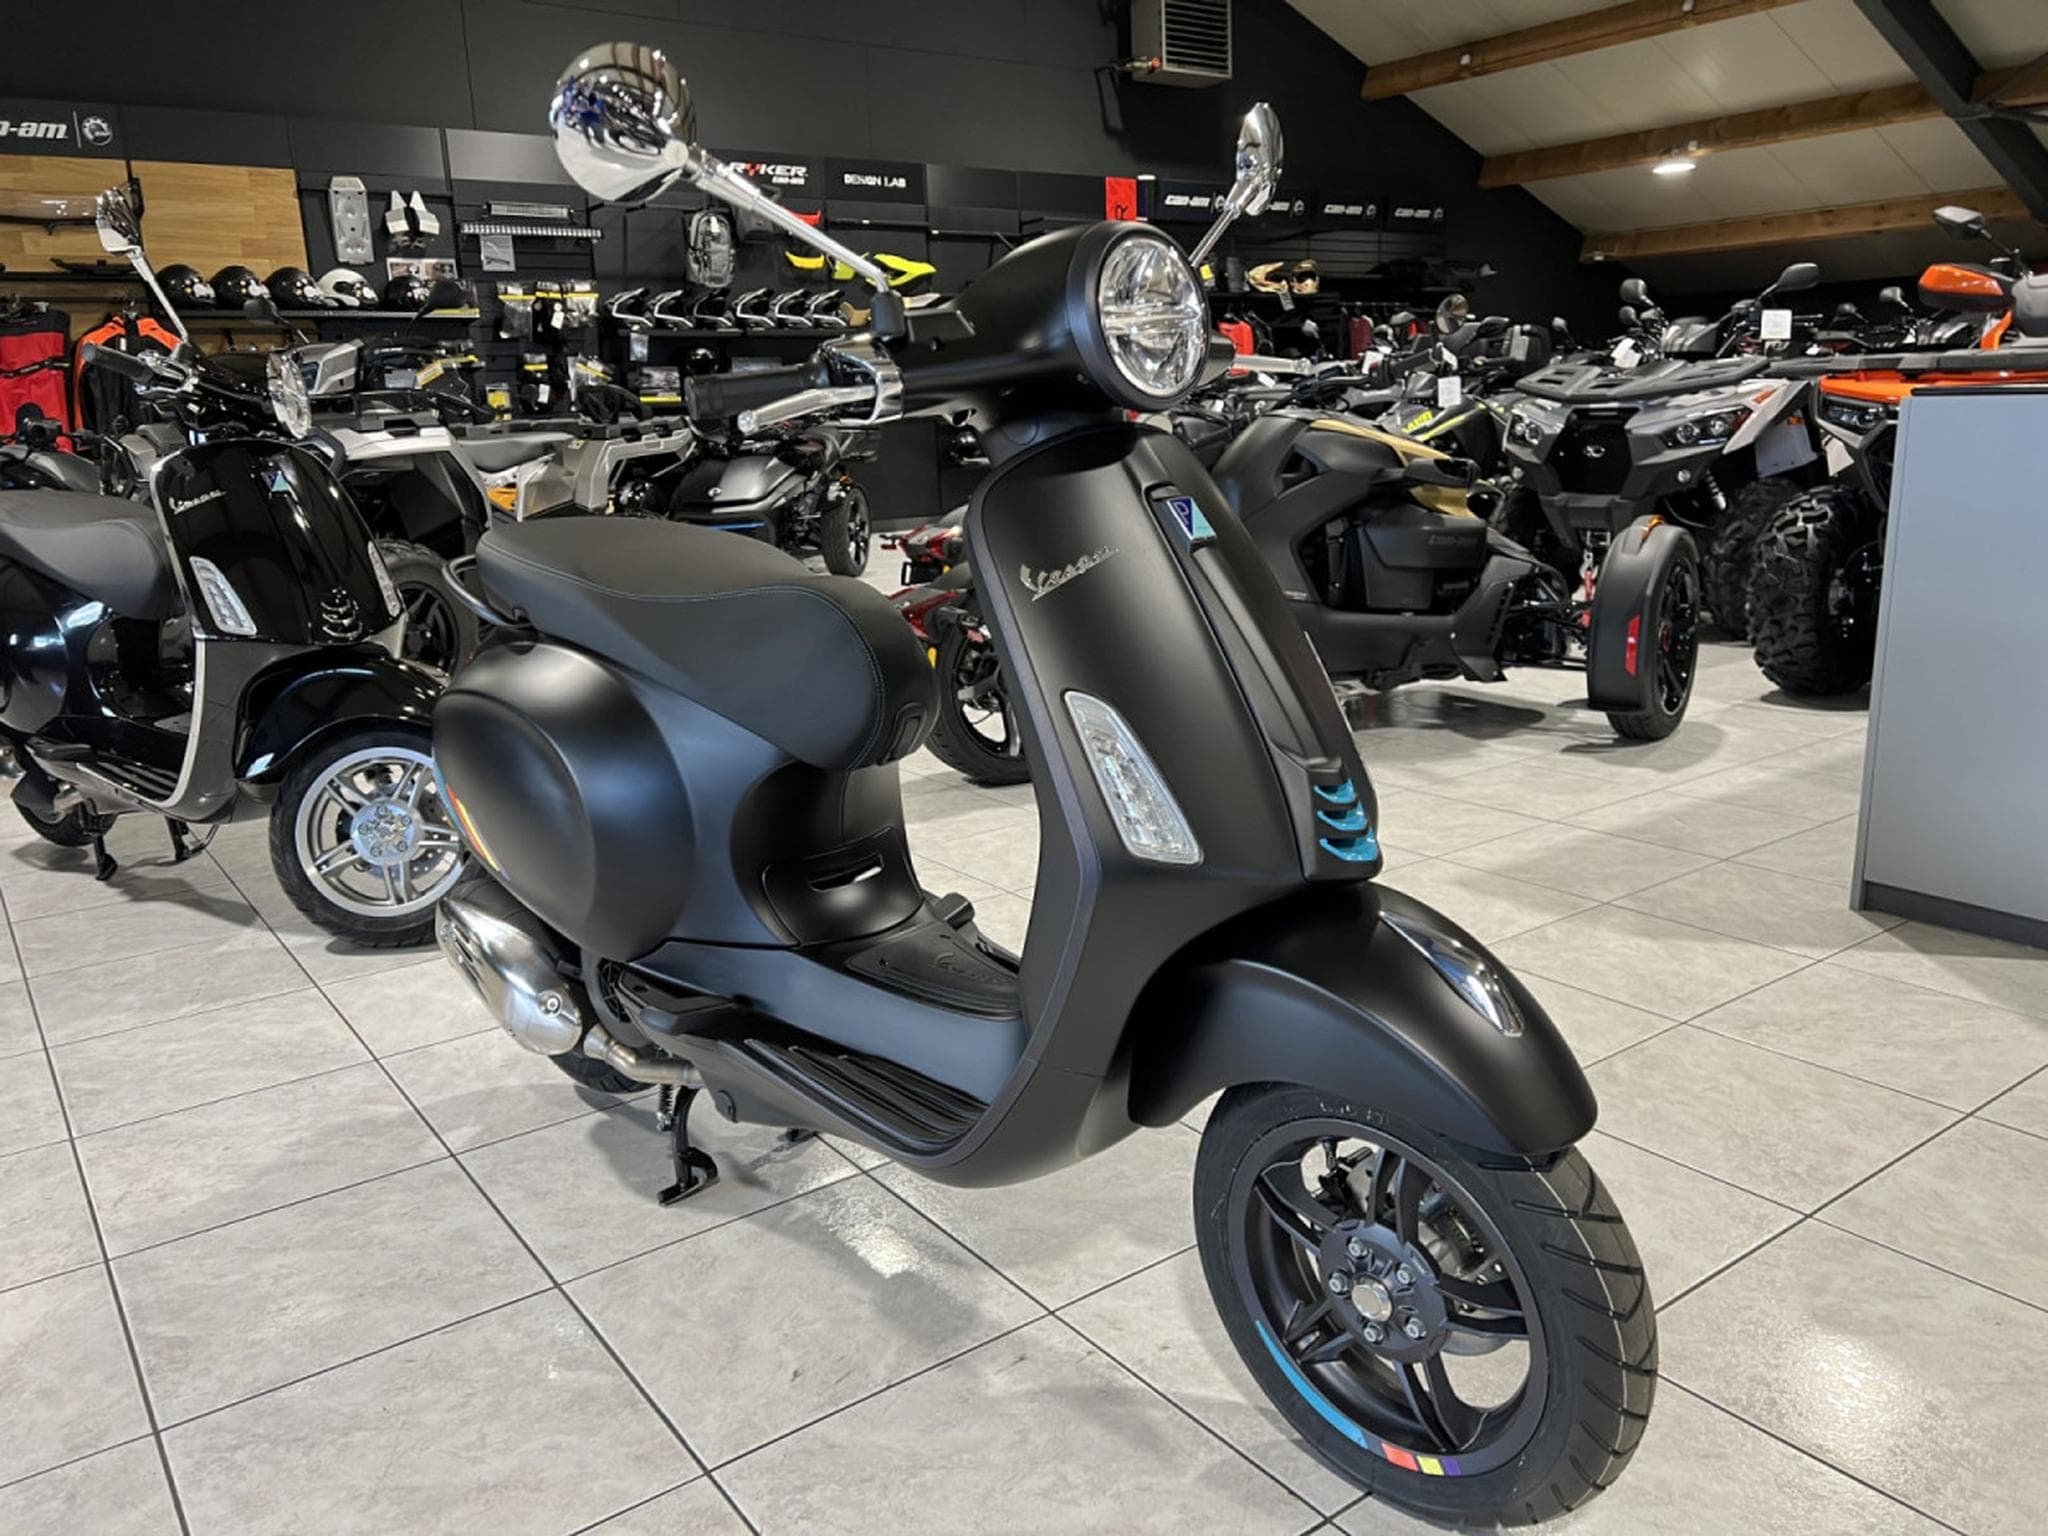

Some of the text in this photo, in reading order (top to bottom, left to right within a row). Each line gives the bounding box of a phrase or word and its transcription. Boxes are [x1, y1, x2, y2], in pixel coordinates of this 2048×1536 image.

[844, 173, 907, 188] DESIGN LAB
[1020, 544, 1120, 602] Vespa
